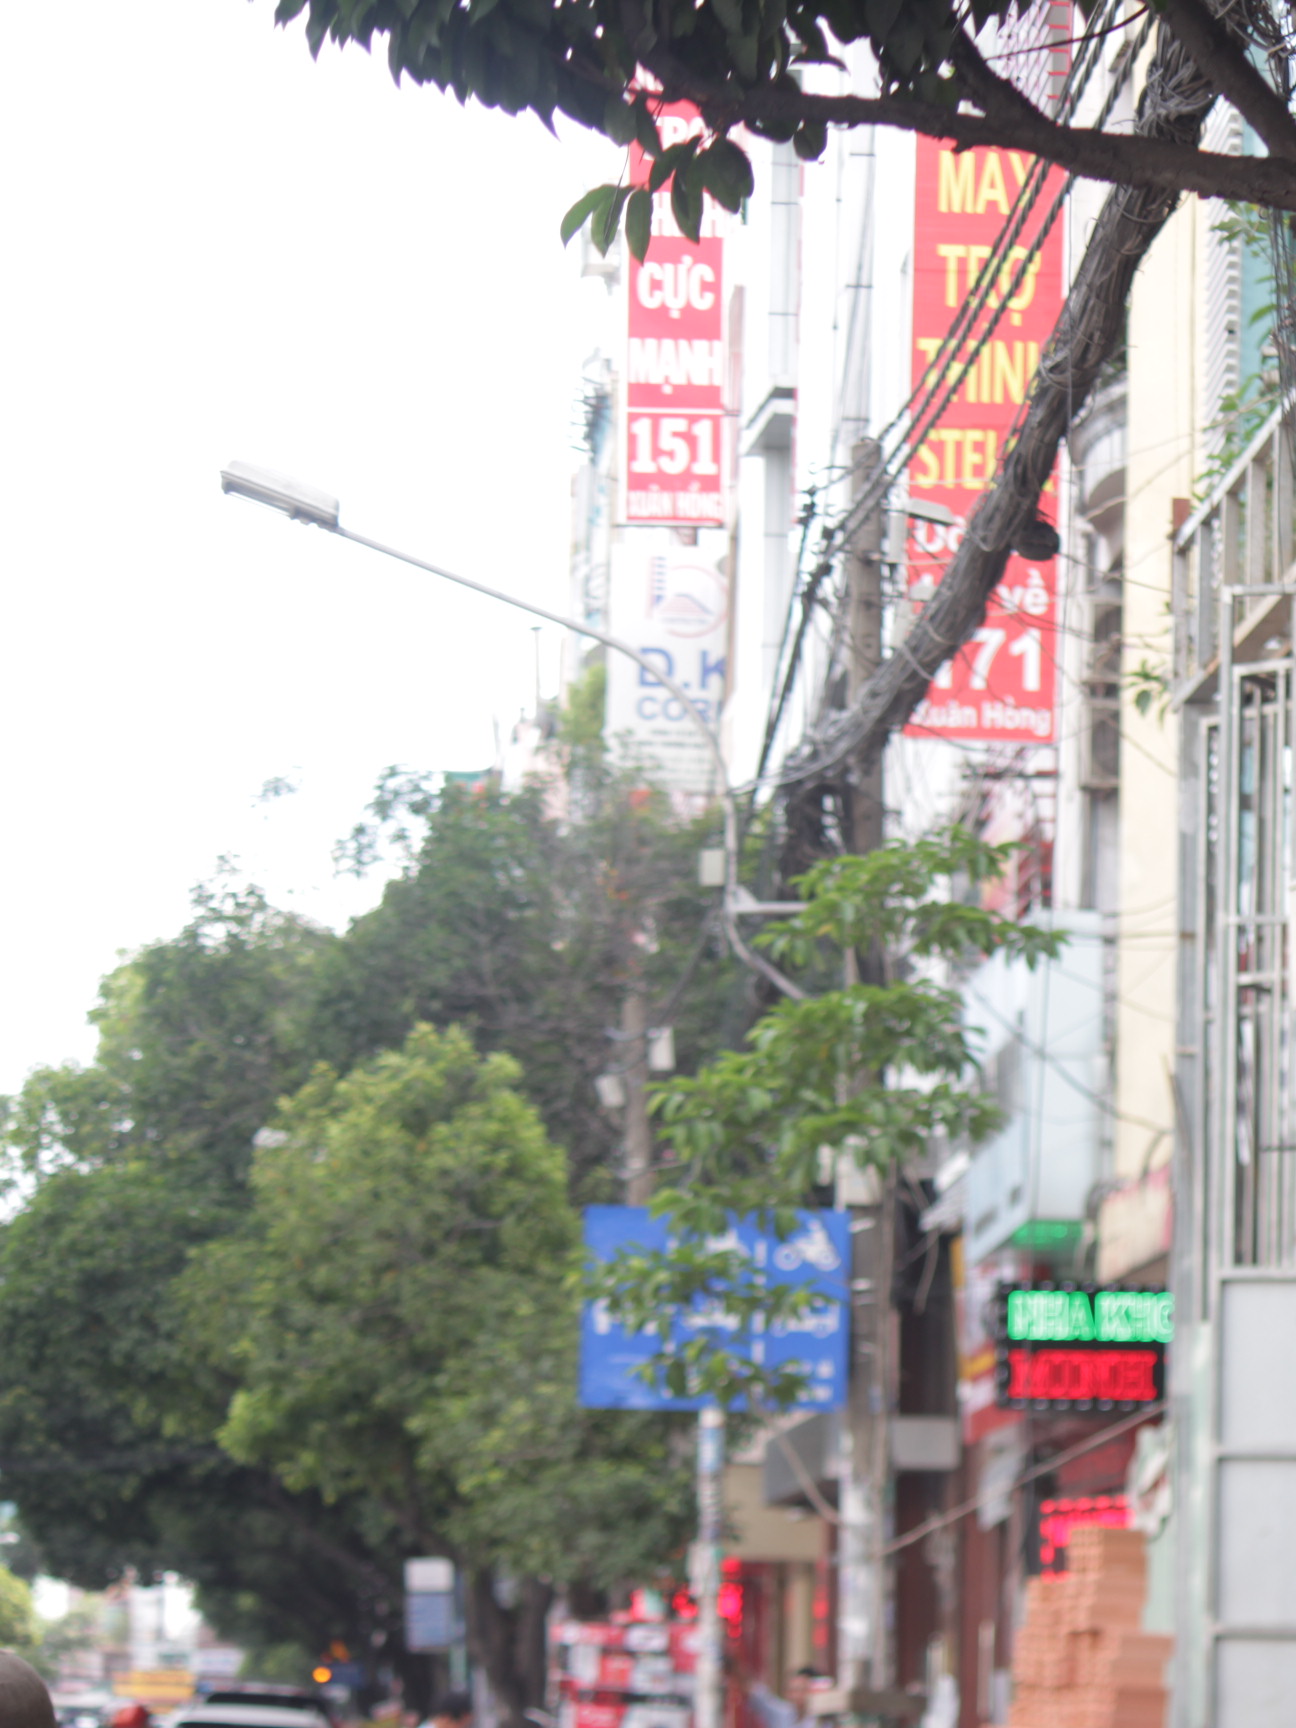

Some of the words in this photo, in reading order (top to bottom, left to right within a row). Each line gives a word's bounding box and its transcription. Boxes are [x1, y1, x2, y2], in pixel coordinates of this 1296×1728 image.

[637, 255, 716, 318] CỰC
[629, 337, 722, 395] MẠNH
[629, 417, 718, 475] 151
